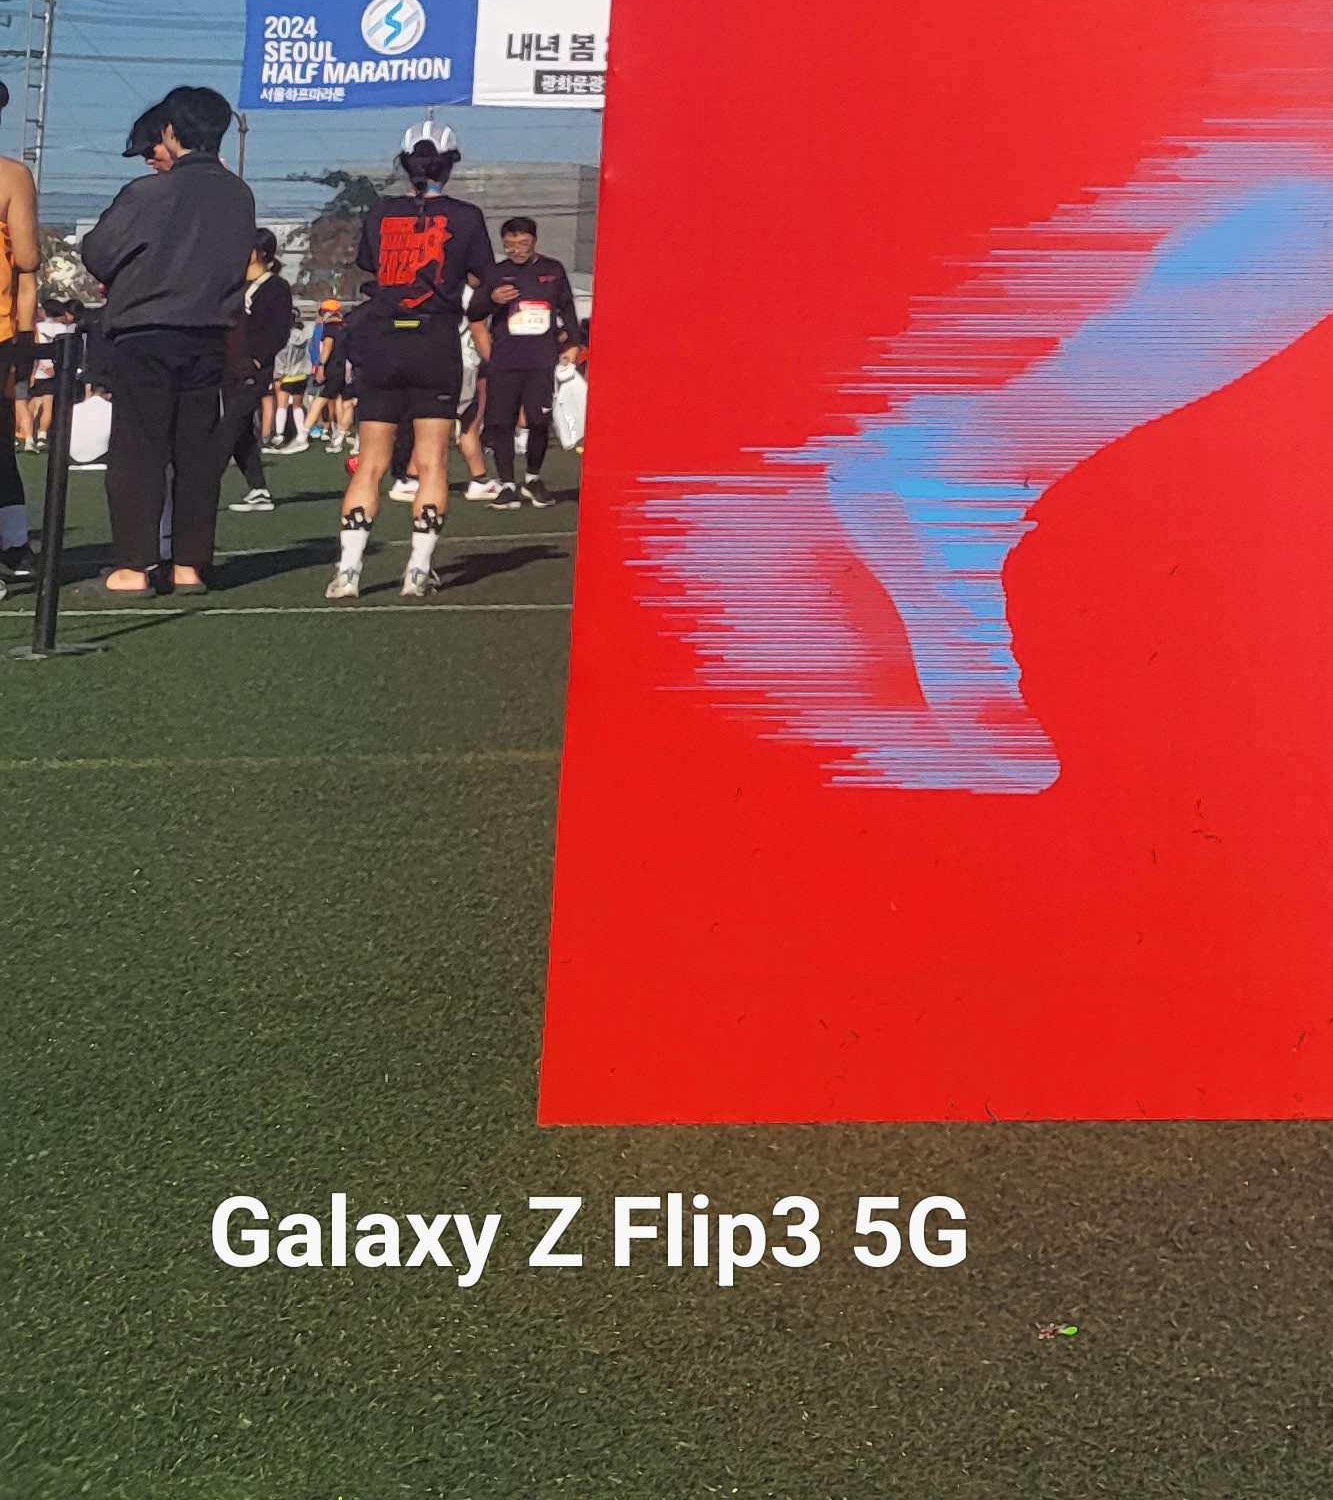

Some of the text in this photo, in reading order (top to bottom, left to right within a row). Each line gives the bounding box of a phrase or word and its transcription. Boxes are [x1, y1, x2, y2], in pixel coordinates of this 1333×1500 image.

[263, 15, 318, 39] 2024
[263, 40, 337, 64] SEOUL
[506, 32, 596, 62] 내년 봄
[261, 57, 452, 85] HALF MARATHON
